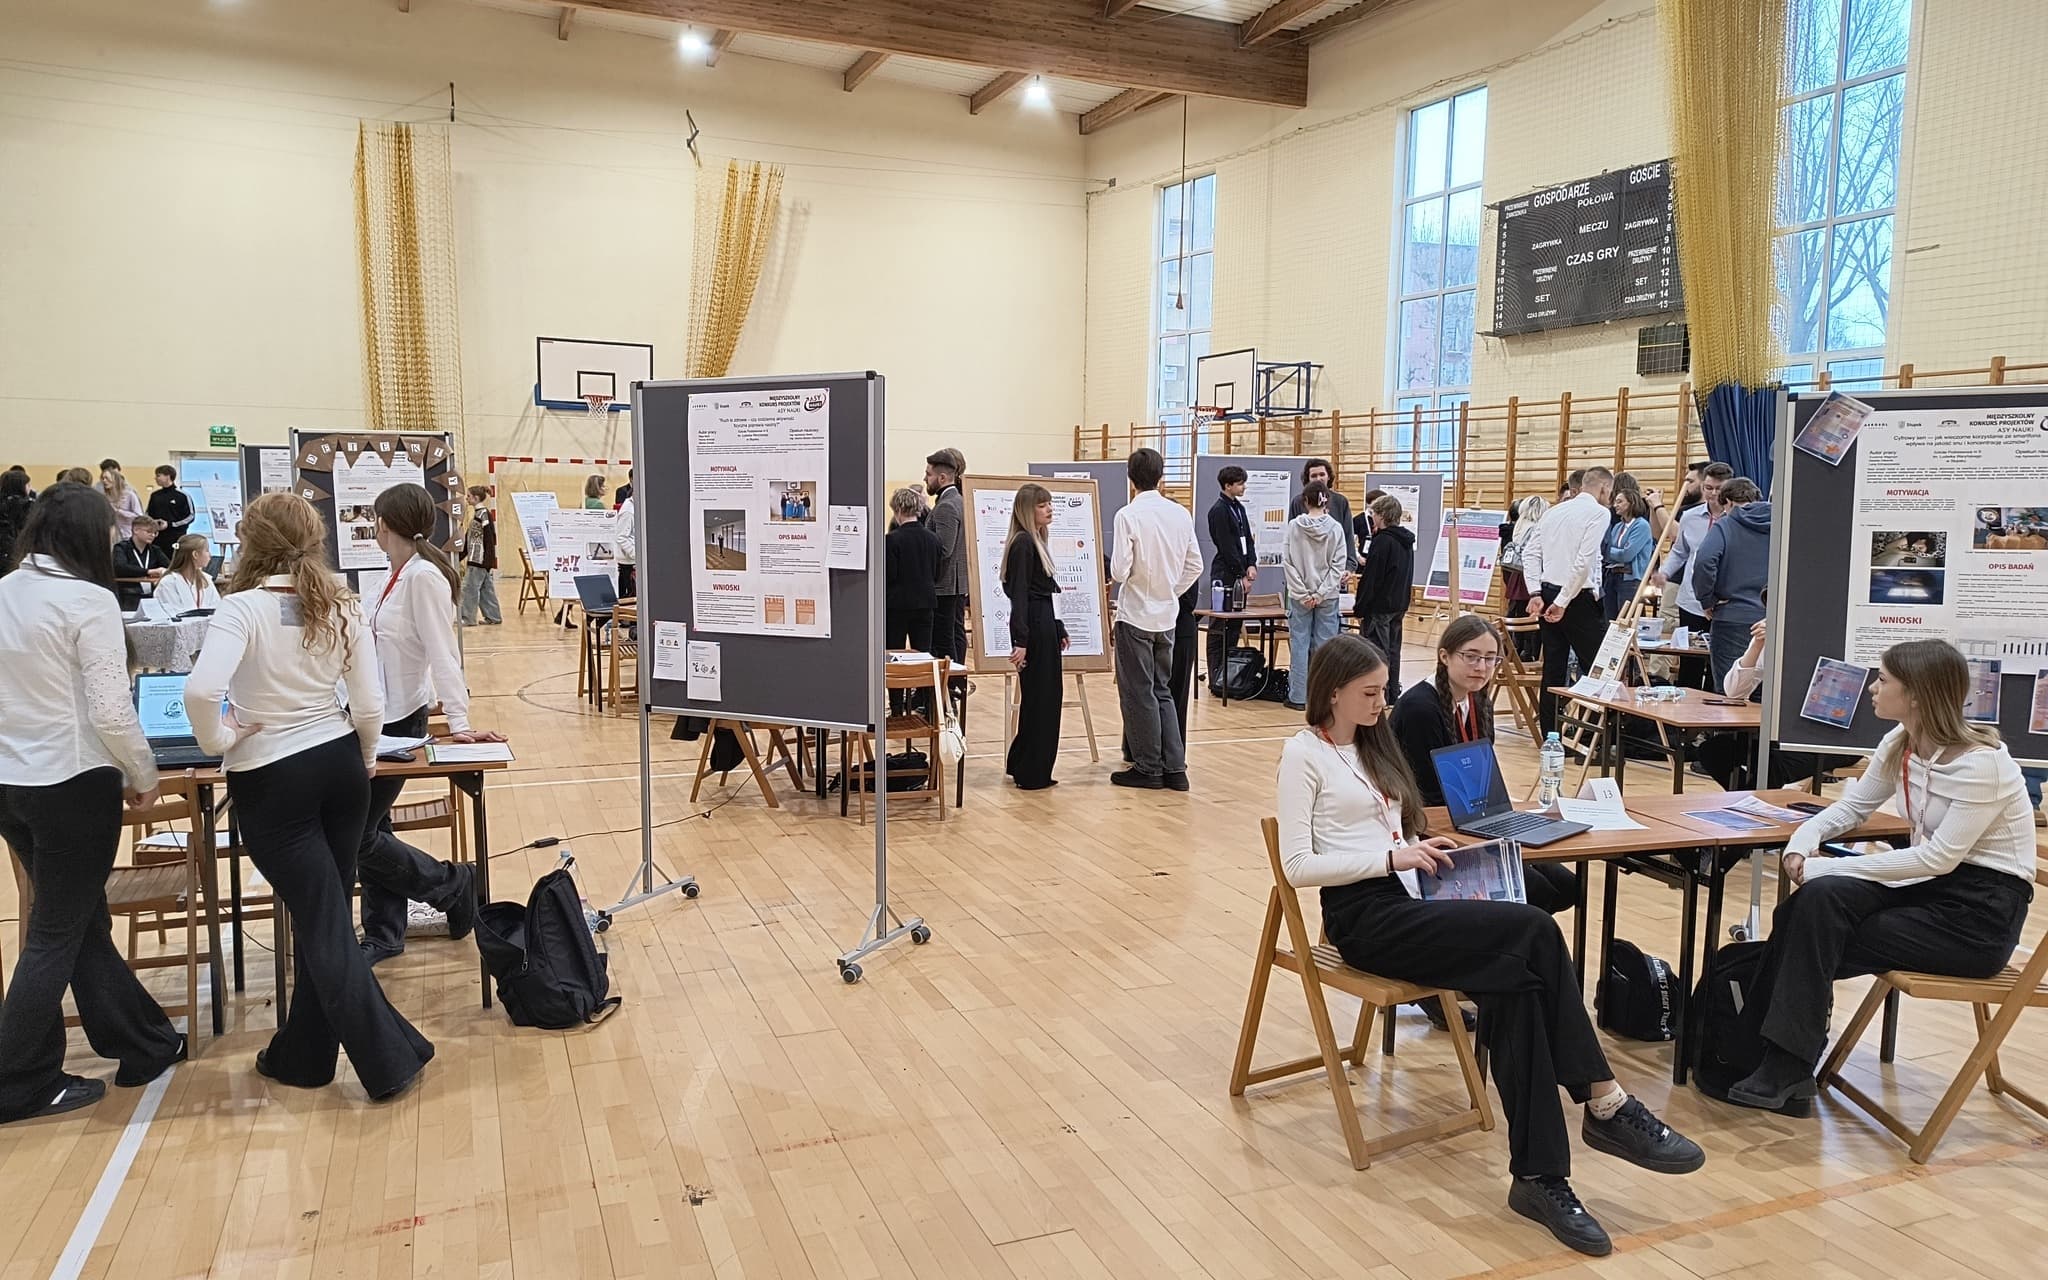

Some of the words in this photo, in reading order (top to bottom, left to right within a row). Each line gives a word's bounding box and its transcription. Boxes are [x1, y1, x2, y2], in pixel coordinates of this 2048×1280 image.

[1534, 182, 1590, 208] GOSPODARZE
[1578, 192, 1614, 208] POŁOWA
[1668, 203, 1672, 211] 6
[1579, 220, 1609, 233] MECZU
[1624, 217, 1659, 230] ZAGRYWKA
[1532, 238, 1562, 250] ZAGRYWKA
[1662, 246, 1671, 255] 10
[1566, 251, 1593, 266] CZAS
[1597, 246, 1620, 260] GRY
[1661, 268, 1670, 276] 12
[1635, 277, 1648, 286] SET
[1661, 279, 1669, 287] 13
[1660, 289, 1668, 297] 14
[1535, 294, 1550, 302] SET
[1660, 300, 1668, 308] 15
[2008, 562, 2034, 570] BADAŃ
[1880, 616, 1922, 625] WNIOSKI
[1603, 789, 1613, 799] 13
